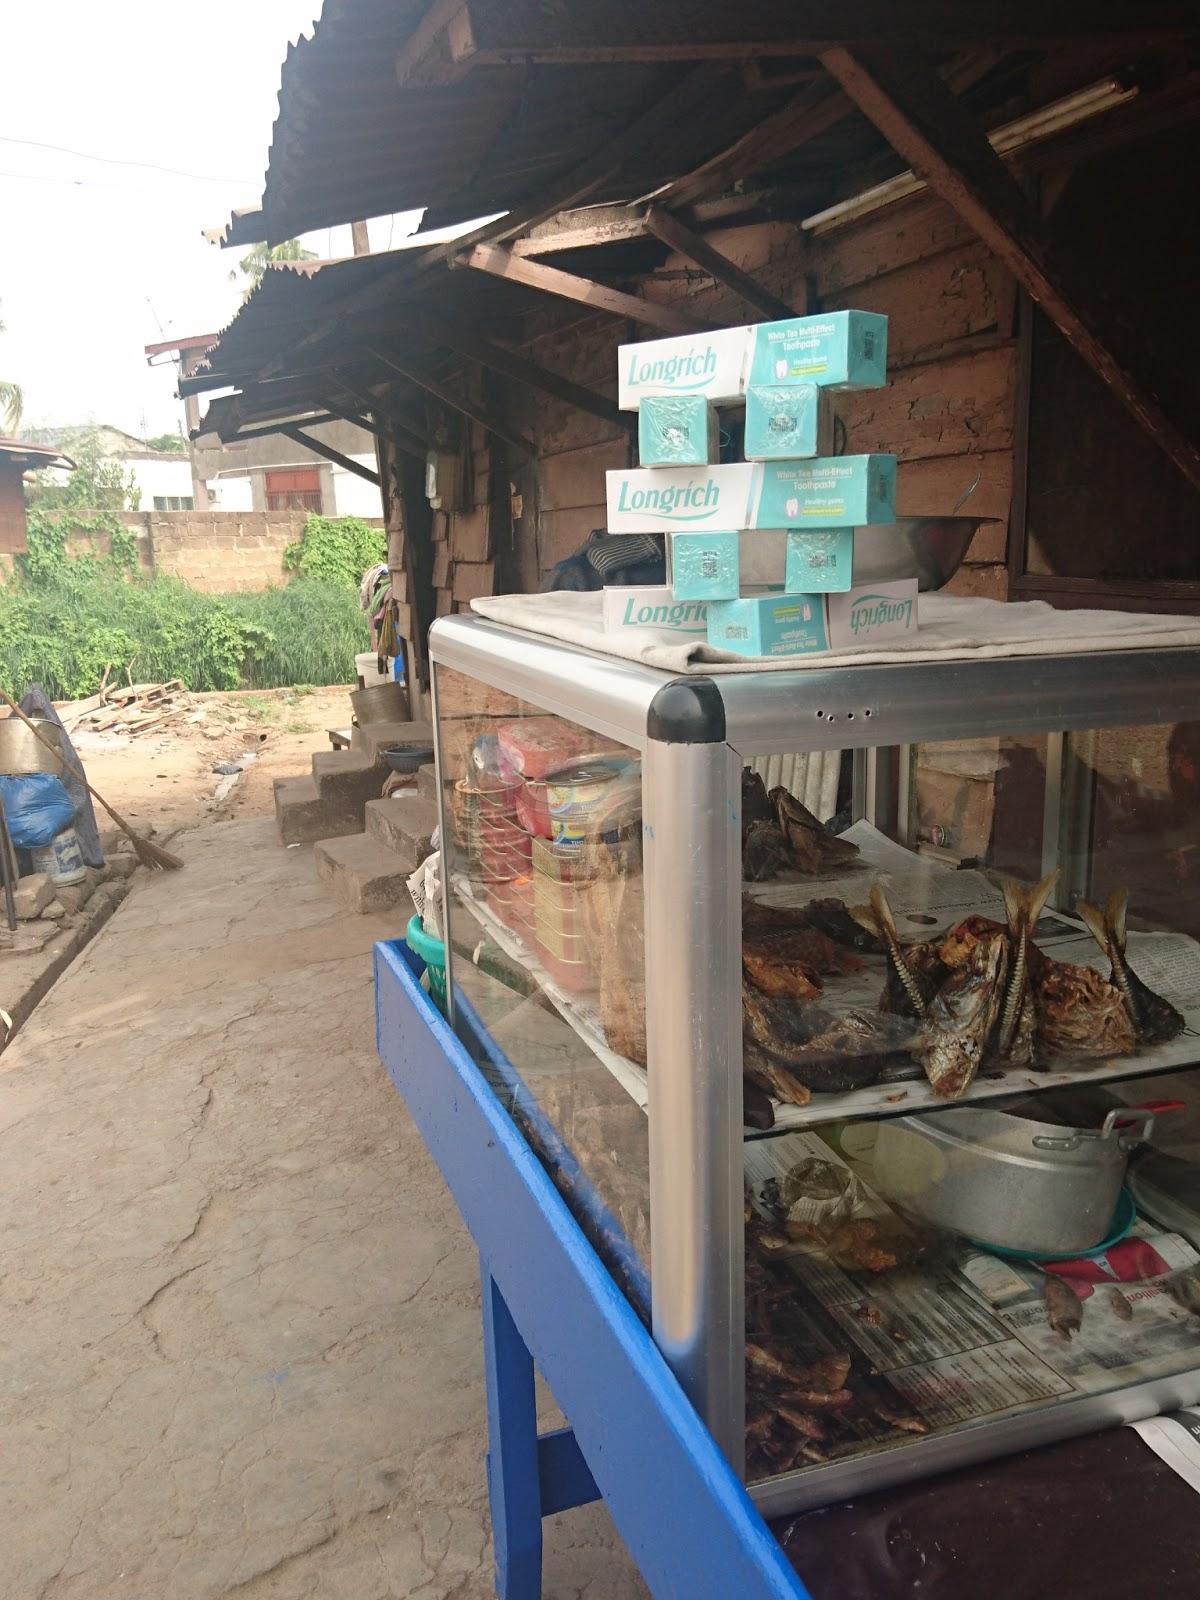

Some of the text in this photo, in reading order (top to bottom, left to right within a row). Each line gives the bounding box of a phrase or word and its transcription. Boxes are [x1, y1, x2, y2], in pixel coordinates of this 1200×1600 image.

[783, 338, 821, 352] Toothpaste
[628, 345, 717, 386] Longrich
[618, 479, 720, 513] Longrich
[793, 480, 837, 491] Toothpaste
[851, 600, 913, 635] Longrich
